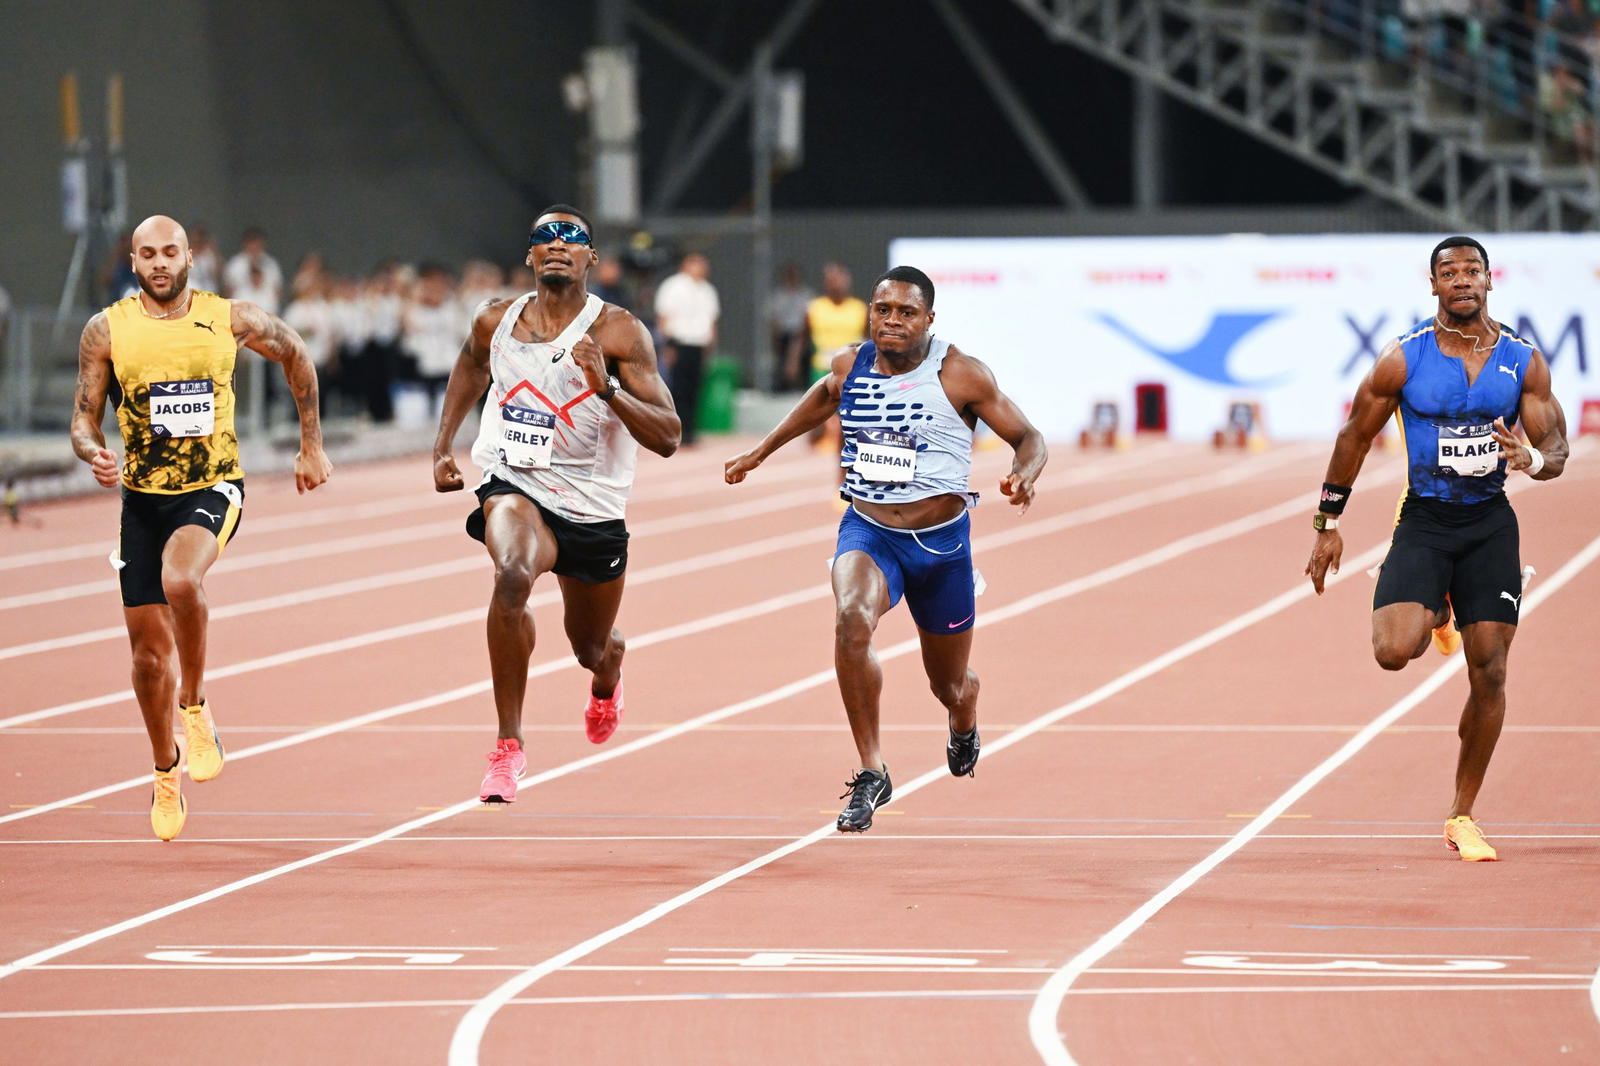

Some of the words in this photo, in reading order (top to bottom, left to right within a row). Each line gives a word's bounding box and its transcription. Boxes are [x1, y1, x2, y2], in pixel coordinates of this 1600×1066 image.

[155, 402, 211, 415] JACOBS
[1441, 440, 1497, 457] BLAKE
[860, 452, 912, 468] COLEMAN
